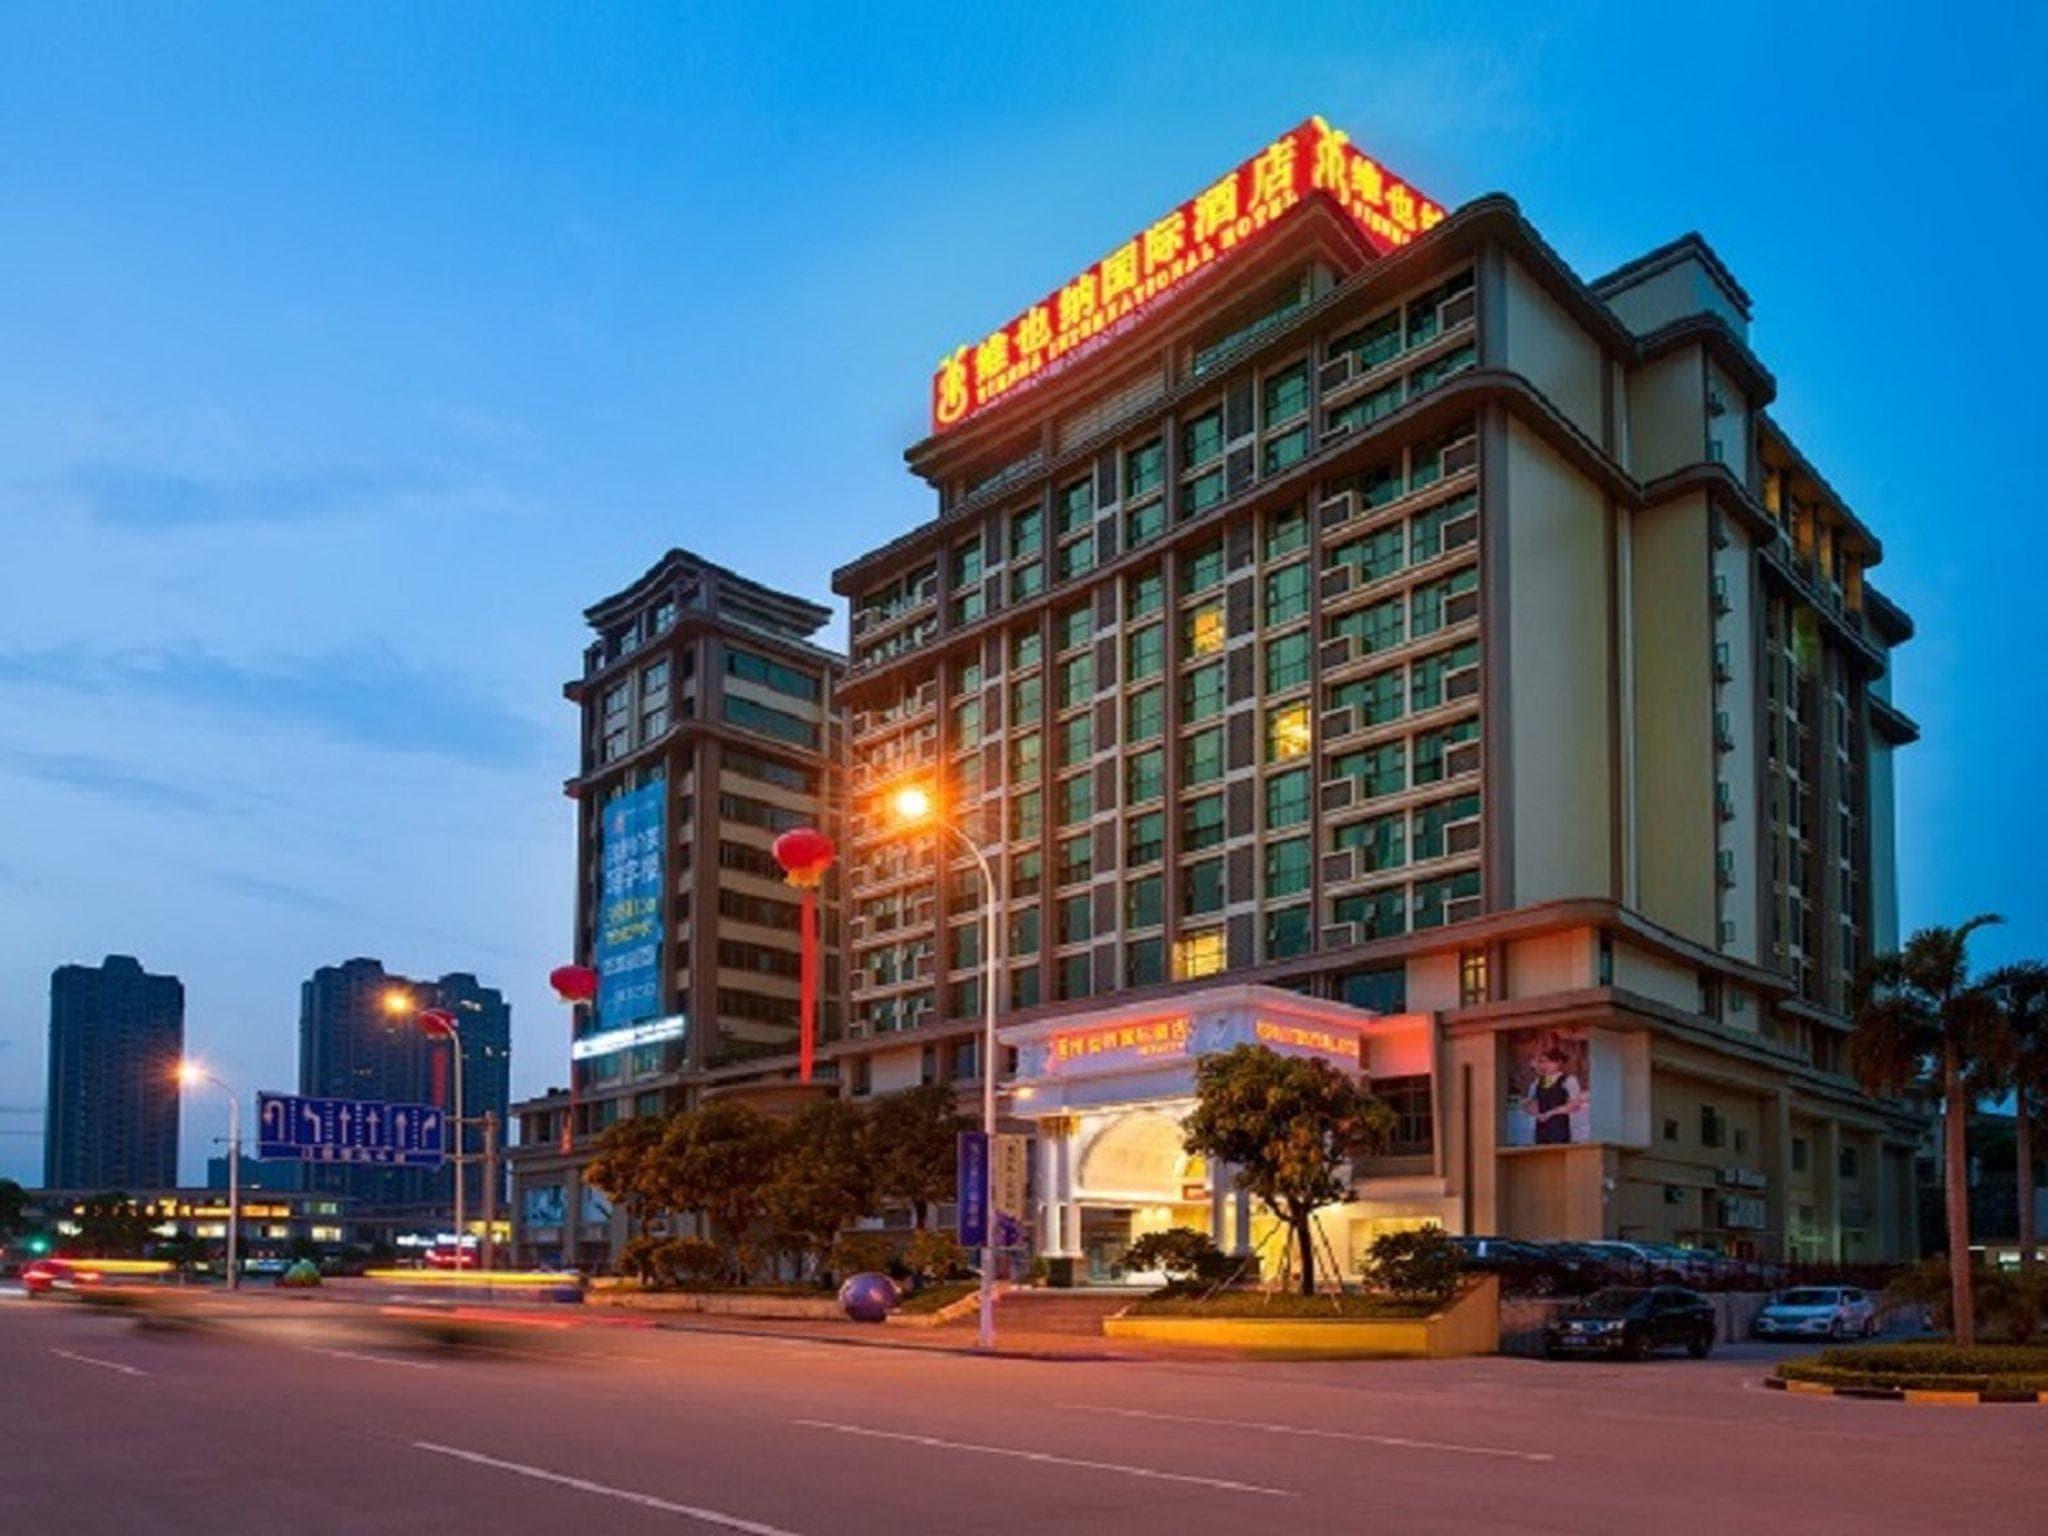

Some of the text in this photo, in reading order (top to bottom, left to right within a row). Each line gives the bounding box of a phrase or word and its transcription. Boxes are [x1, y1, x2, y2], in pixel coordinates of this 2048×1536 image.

[976, 188, 1299, 404] VIENNA INTERNATIONAL HOTEL
[977, 136, 1298, 382] 维也纳国际酒店
